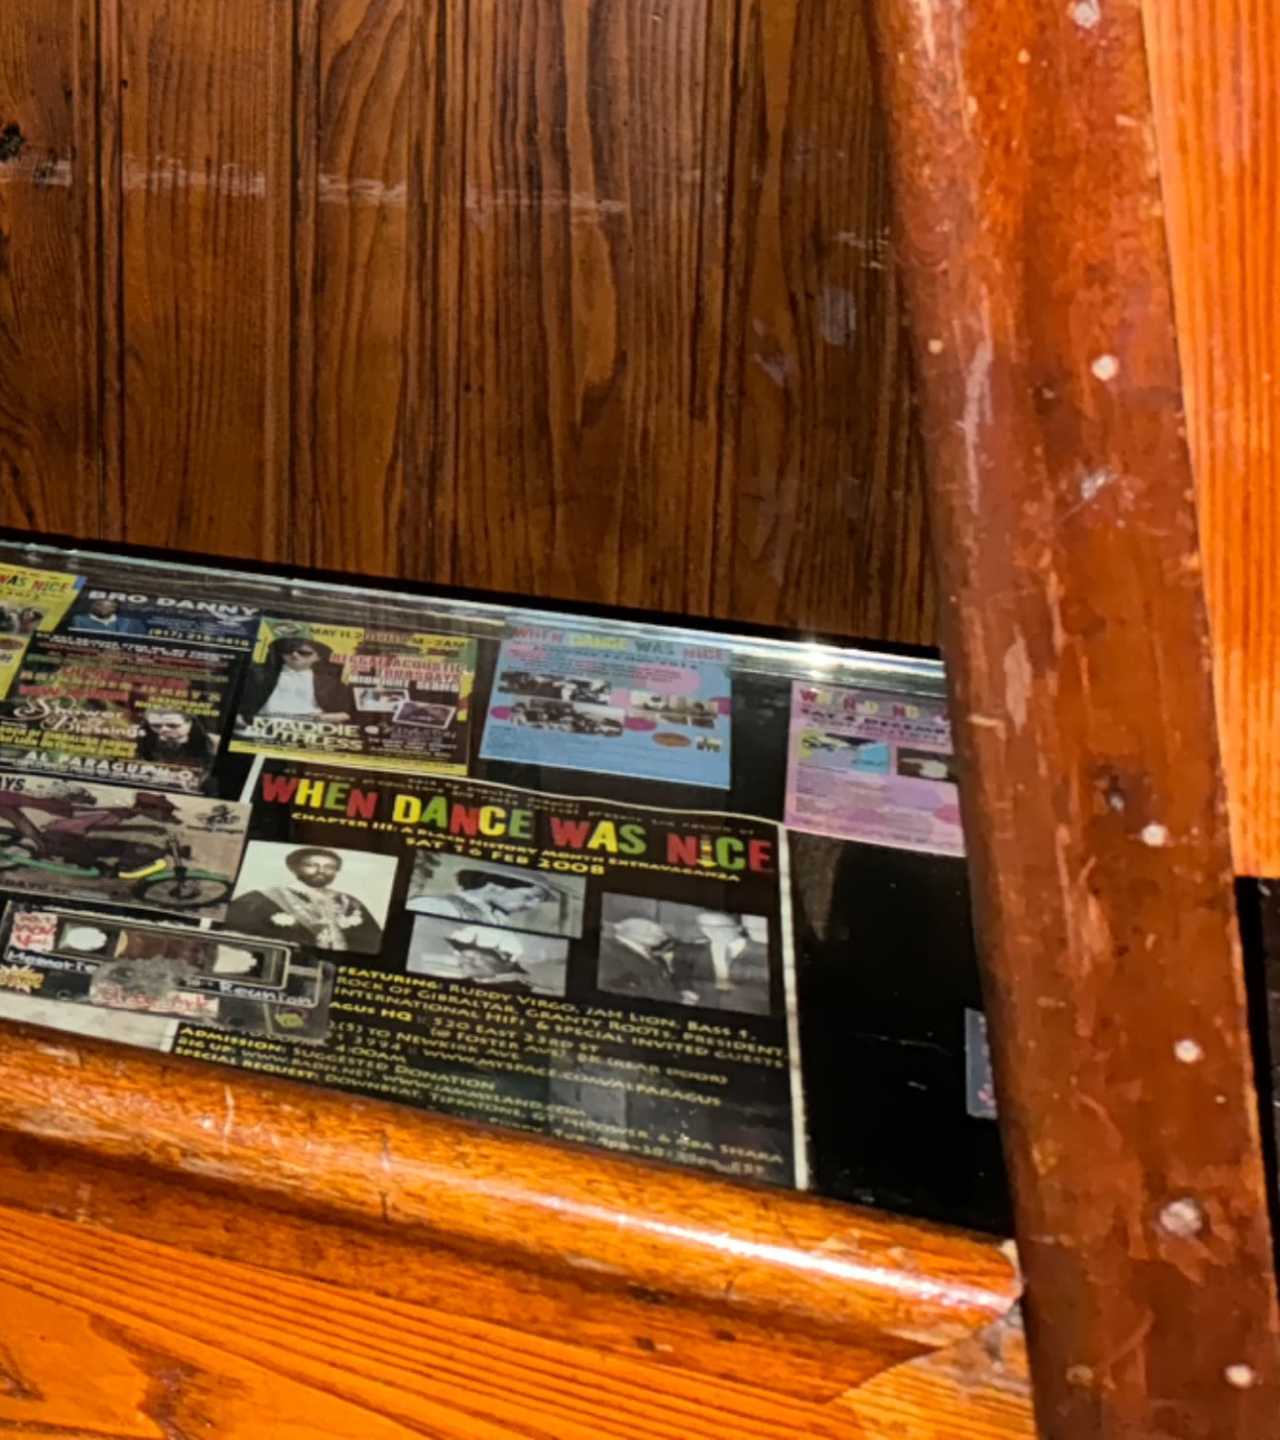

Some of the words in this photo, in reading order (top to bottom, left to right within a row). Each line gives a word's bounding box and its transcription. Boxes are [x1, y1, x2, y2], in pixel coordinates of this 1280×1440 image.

[31, 578, 73, 594] NICE
[87, 589, 149, 604] BRO
[155, 596, 260, 616] DANNY
[634, 639, 676, 657] WAS
[253, 716, 361, 738] MADDIE
[260, 771, 382, 821] WHEN
[391, 792, 535, 843] DANCE
[548, 814, 648, 857] WAS
[664, 831, 775, 875] NICE
[291, 811, 369, 830] CHAPTER
[467, 836, 539, 858] HISTORY
[403, 836, 446, 851] SAT
[453, 844, 485, 858] 16
[490, 849, 531, 867] FEB
[535, 857, 607, 878] 2008
[334, 975, 388, 993] ROCK
[391, 984, 411, 997] OF
[336, 964, 443, 990] FEATURING:
[585, 1006, 624, 1020] JAH
[686, 1019, 733, 1037] BASS
[328, 999, 376, 1016] AGUS
[379, 1008, 414, 1024] HQ
[474, 1023, 520, 1040] EAST
[523, 1032, 575, 1050] 23RD
[332, 986, 481, 1021] INTERNATIONAL
[553, 1022, 625, 1044] SPECIAL
[630, 1036, 710, 1058] INVITED
[712, 1050, 785, 1070] GUESTS
[367, 1027, 392, 1040] TO
[394, 1031, 487, 1054] NEWKIRK
[173, 1044, 238, 1067] SPECIAL
[179, 1024, 287, 1053] ADMISSION:
[291, 1046, 390, 1073] SUGGESTED
[393, 1063, 496, 1091] DONATION
